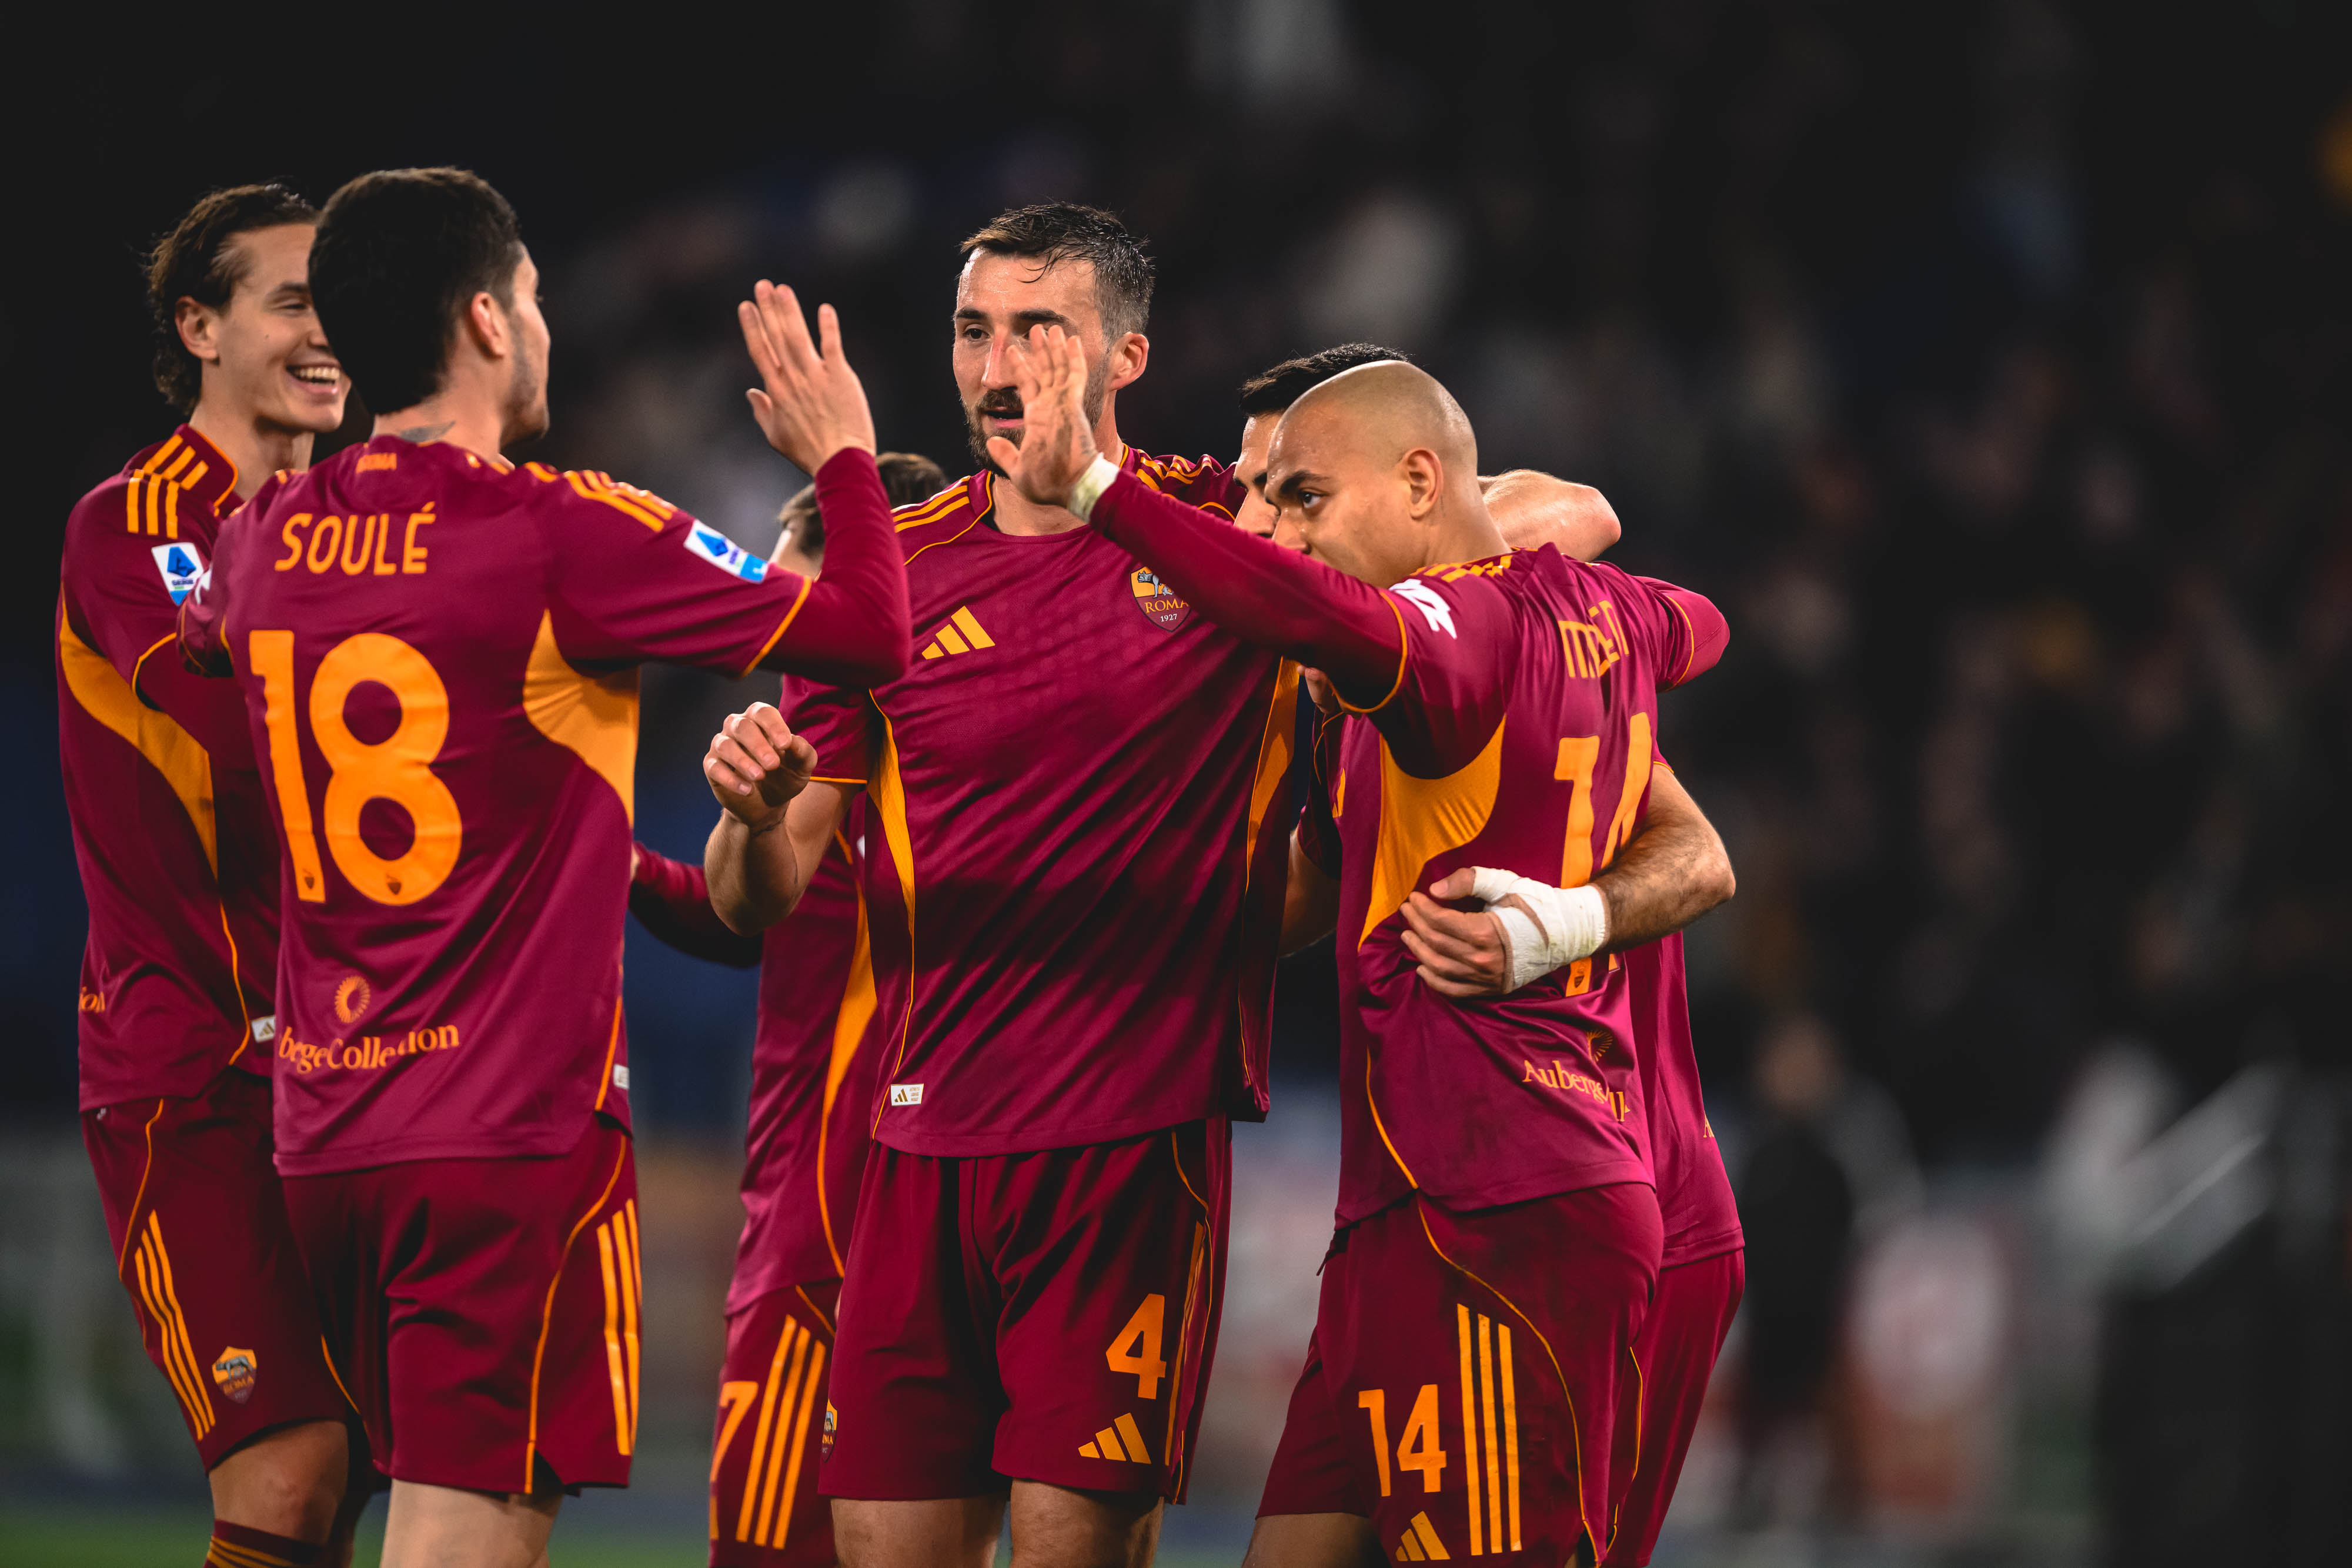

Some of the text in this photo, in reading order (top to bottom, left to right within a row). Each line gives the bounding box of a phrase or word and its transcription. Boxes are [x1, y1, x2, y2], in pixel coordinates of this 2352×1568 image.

[275, 501, 436, 576] SOULÉ
[1144, 598, 1190, 613] ROMA
[1160, 613, 1177, 622] 1927
[249, 630, 462, 906] 18
[1105, 1293, 1167, 1400] 4
[710, 1381, 759, 1482] 7
[1358, 1384, 1447, 1497] 14
